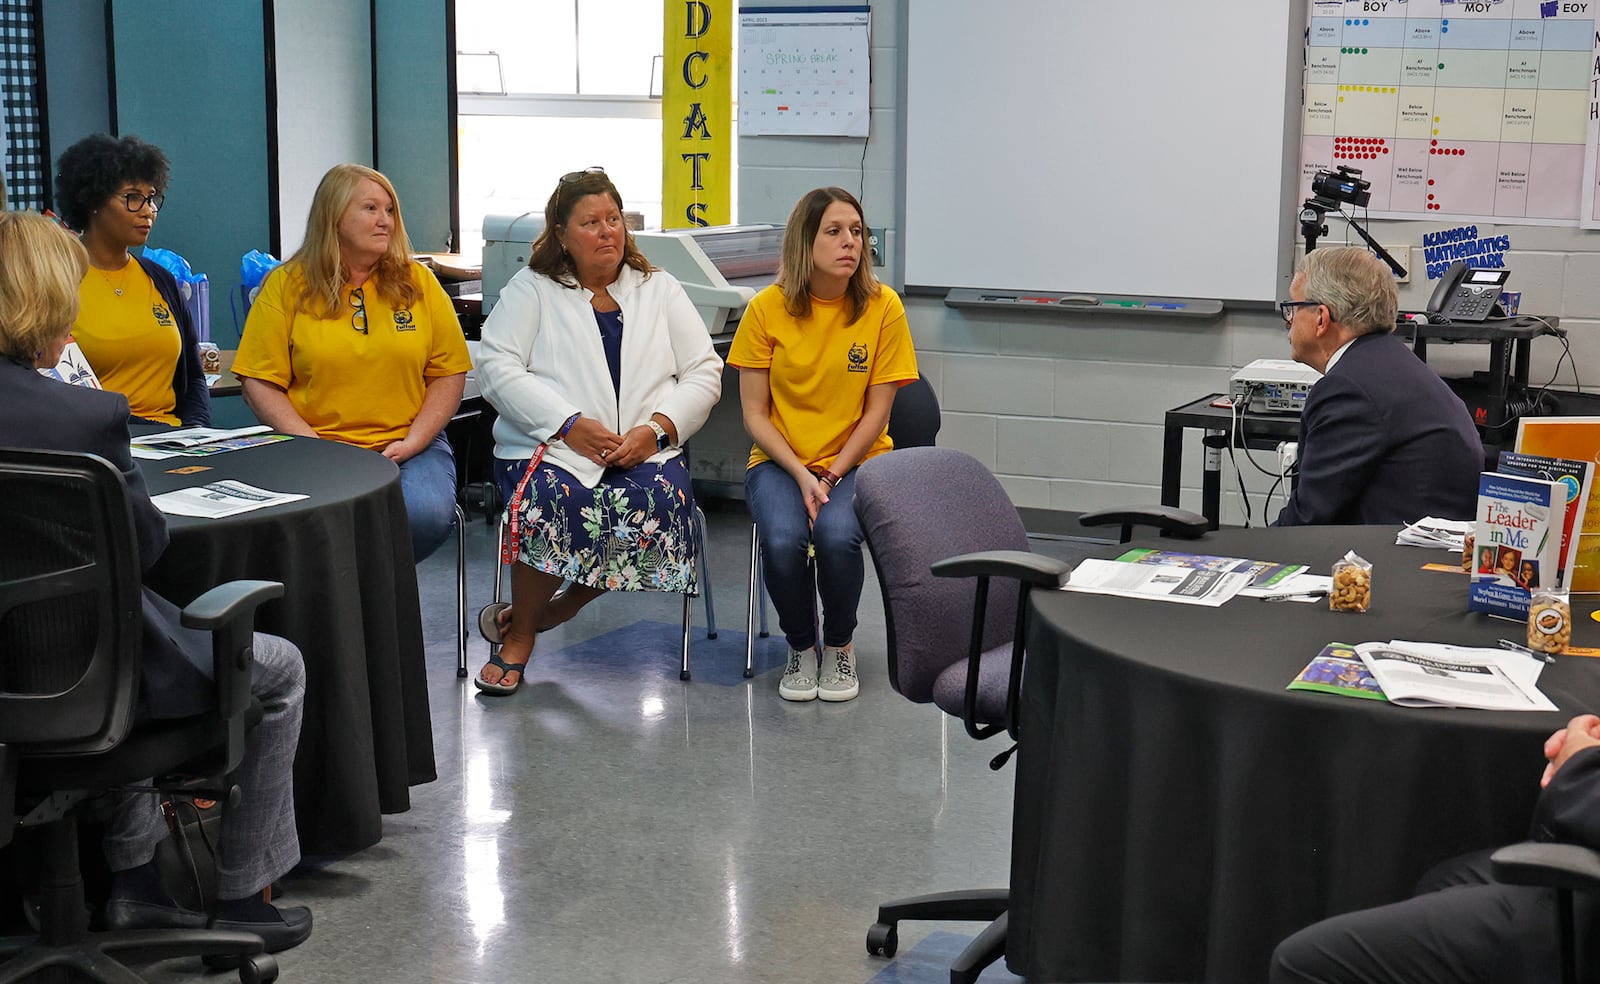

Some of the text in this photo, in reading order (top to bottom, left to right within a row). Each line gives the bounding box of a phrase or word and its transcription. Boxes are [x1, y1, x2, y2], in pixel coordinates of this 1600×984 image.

[1364, 2, 1388, 12] BOY
[1464, 4, 1491, 13] MOY
[1563, 4, 1588, 13] EOY
[766, 53, 838, 65] SPRING BREAK
[1516, 457, 1551, 465] INTERNATIONAL
[1494, 501, 1509, 513] The
[1485, 505, 1538, 531] Leader
[1489, 525, 1529, 549] in Me
